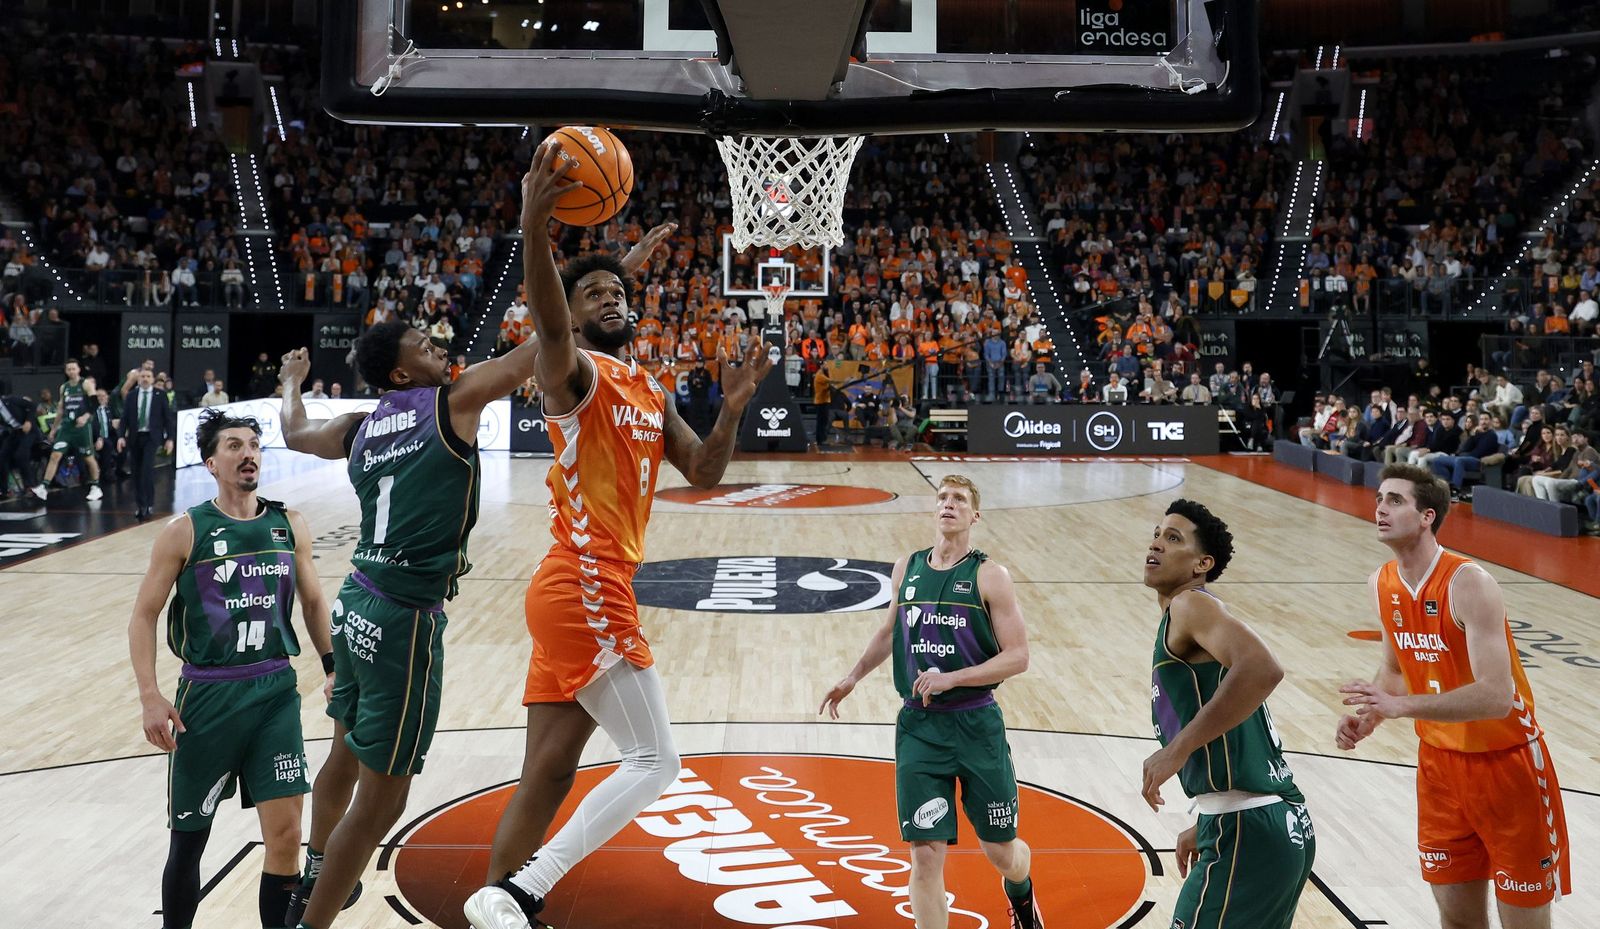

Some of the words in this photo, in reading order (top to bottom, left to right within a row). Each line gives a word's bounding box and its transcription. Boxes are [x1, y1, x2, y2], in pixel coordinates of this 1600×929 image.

[1081, 8, 1118, 28] liga
[1081, 28, 1166, 46] endesa
[128, 338, 164, 348] SALIDA
[182, 338, 221, 348] SALIDA
[320, 339, 352, 348] SALID
[1199, 346, 1228, 356] ALIDA
[757, 428, 791, 437] hummel
[1004, 416, 1061, 436] Midea
[1093, 424, 1115, 436] SH
[1147, 422, 1184, 440] TKE
[640, 457, 650, 497] 8
[373, 475, 395, 544] 1
[241, 562, 290, 578] Unicaja
[696, 557, 778, 610] PULEVA
[347, 611, 383, 641] COSTA
[922, 613, 967, 629] Unicaja
[236, 621, 266, 652] 14
[344, 623, 355, 641] DEL
[356, 633, 378, 653] SOL
[345, 634, 374, 664] LAGA
[1414, 651, 1440, 662] BAET
[273, 752, 292, 761] sabor
[279, 754, 300, 770] má
[275, 768, 301, 783] laga
[992, 802, 1012, 818] má
[989, 815, 1012, 829] laga
[634, 768, 859, 929] AMES
[1420, 852, 1447, 861] LEVA
[1497, 873, 1542, 892] Midea
